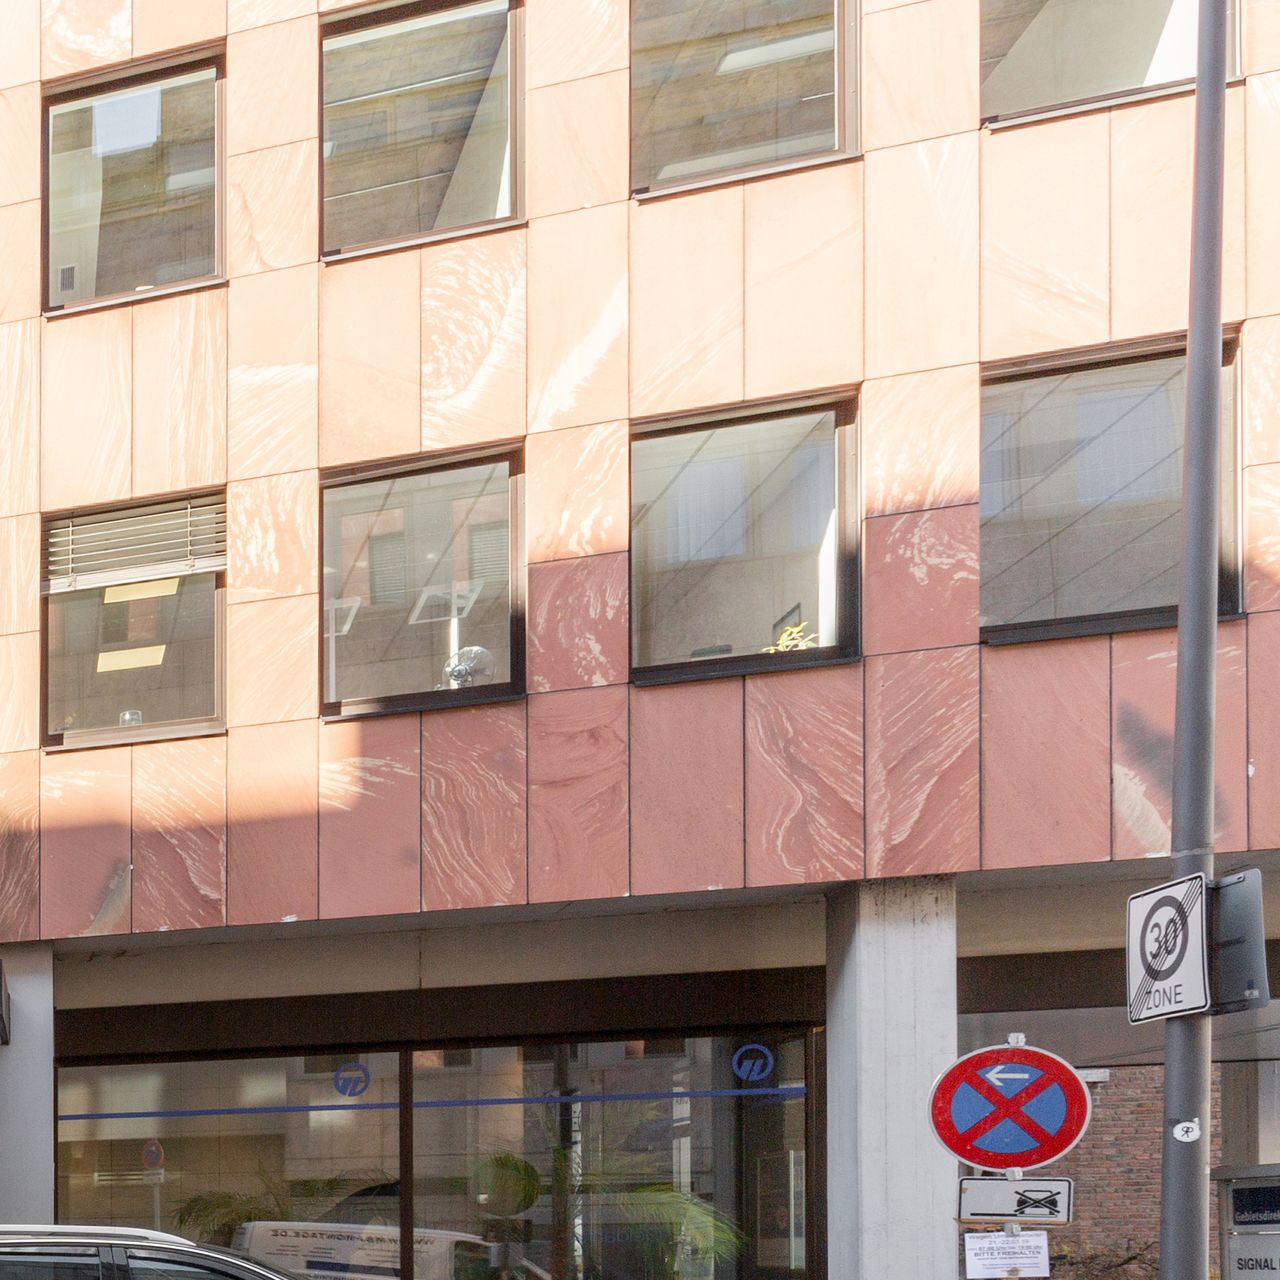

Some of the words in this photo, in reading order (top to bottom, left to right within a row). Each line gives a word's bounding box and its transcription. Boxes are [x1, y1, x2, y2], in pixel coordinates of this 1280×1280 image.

[1150, 918, 1178, 960] 30
[1146, 984, 1183, 1010] ZONE
[1236, 1257, 1277, 1270] SIGNAL
